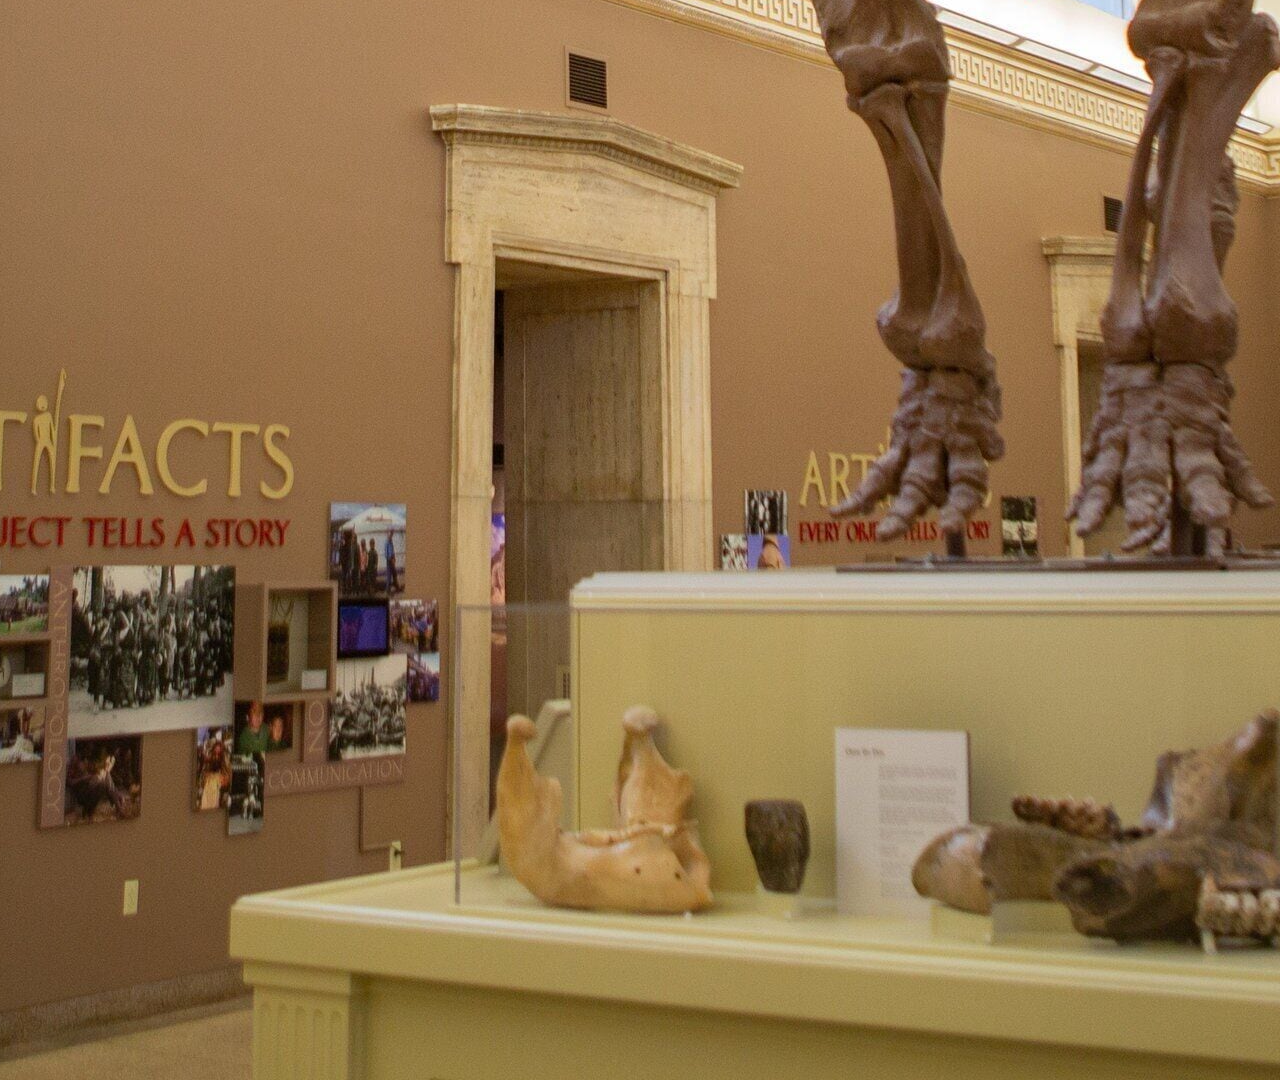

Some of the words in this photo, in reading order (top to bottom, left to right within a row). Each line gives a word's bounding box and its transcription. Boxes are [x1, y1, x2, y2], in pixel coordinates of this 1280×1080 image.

[82, 517, 166, 548] TELLS
[173, 518, 196, 548] A
[205, 518, 291, 548] STORY
[799, 521, 841, 544] EVERY
[47, 580, 67, 817] ANTHROPOLOGY
[269, 759, 404, 789] COMMUNICATION
